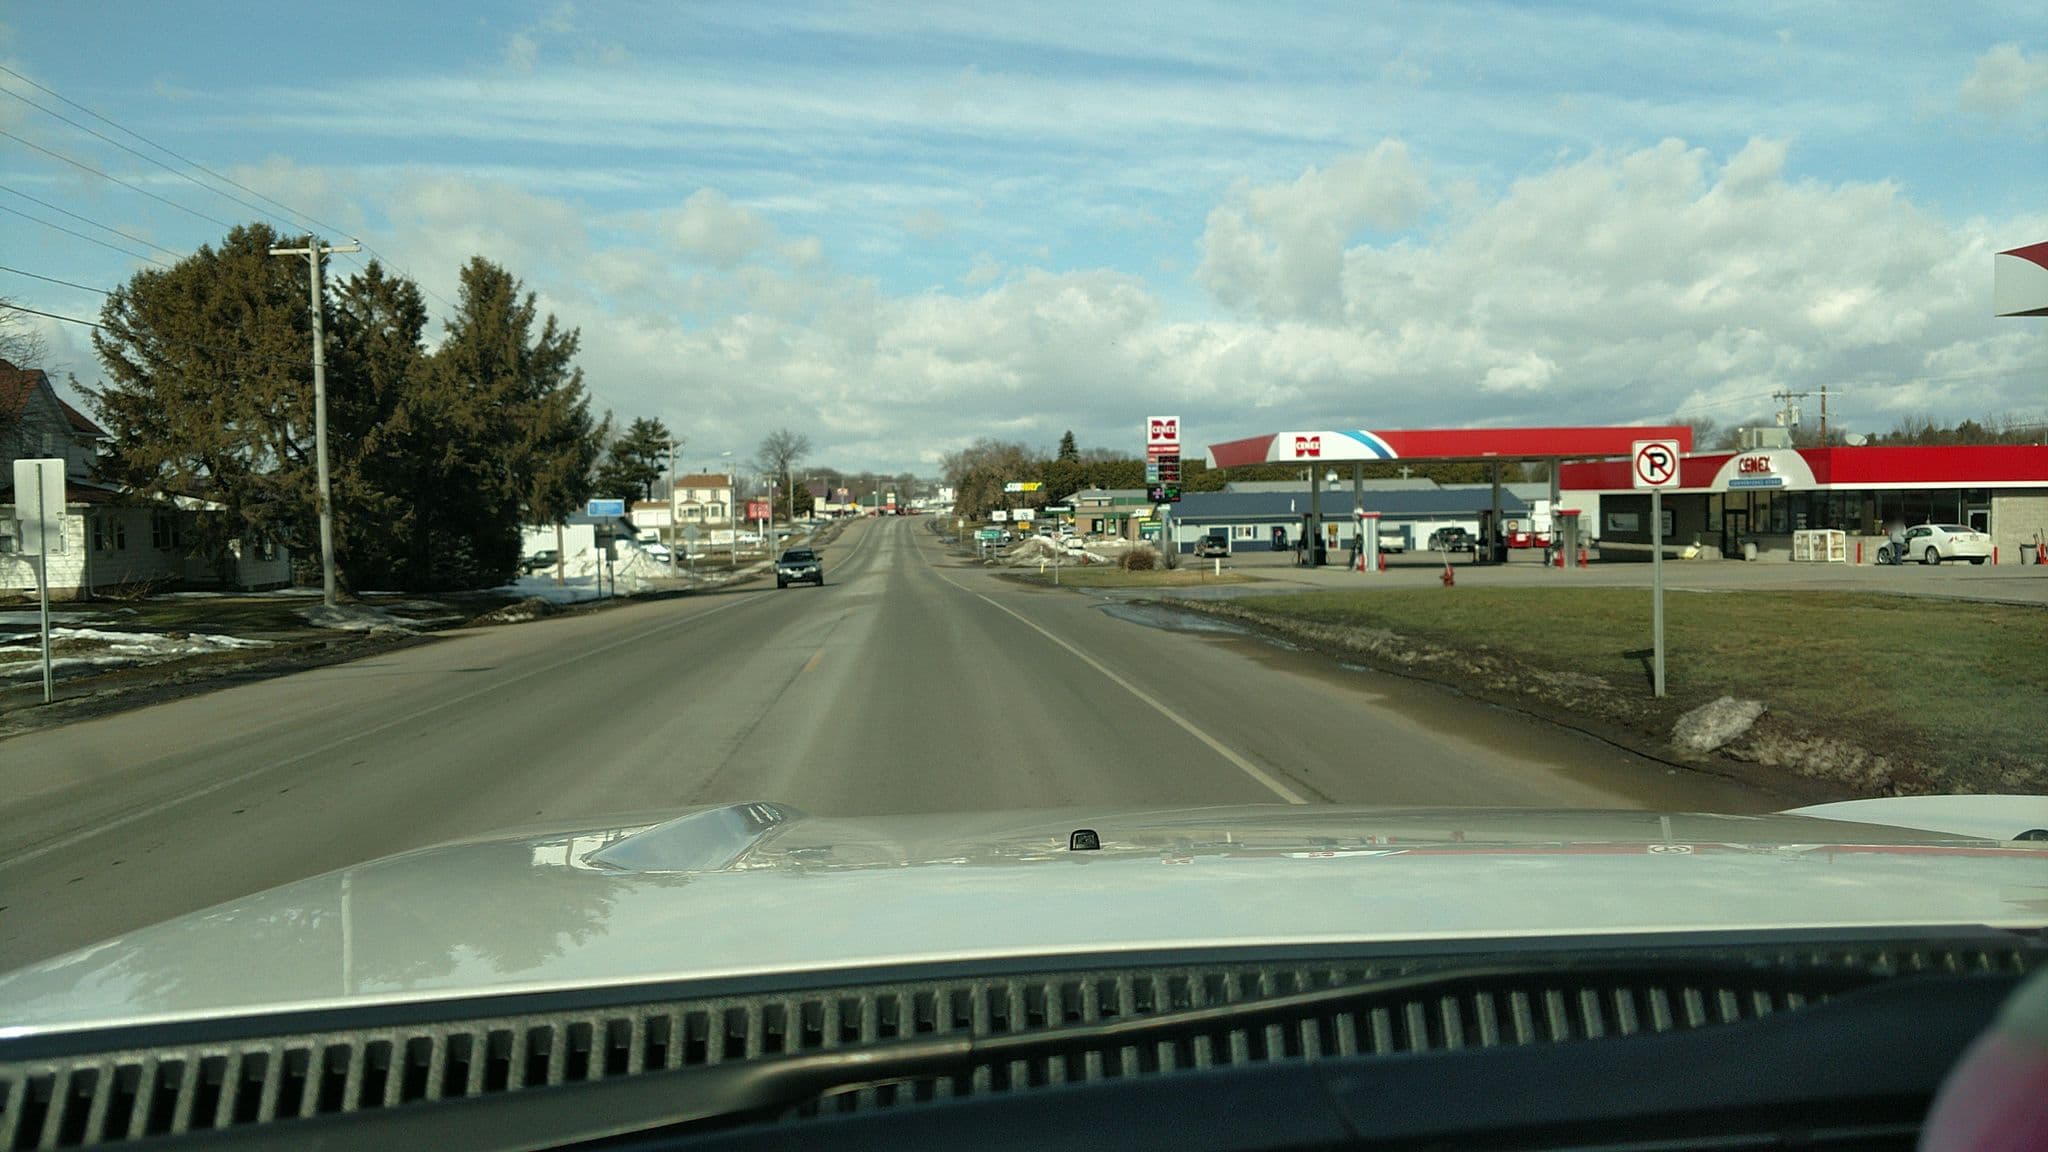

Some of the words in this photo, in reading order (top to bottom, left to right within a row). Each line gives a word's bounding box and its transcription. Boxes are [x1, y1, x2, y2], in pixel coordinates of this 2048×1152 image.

[1649, 452, 1668, 477] P
[1739, 456, 1770, 473] CENEX
[1004, 482, 1042, 492] SUBWAY
